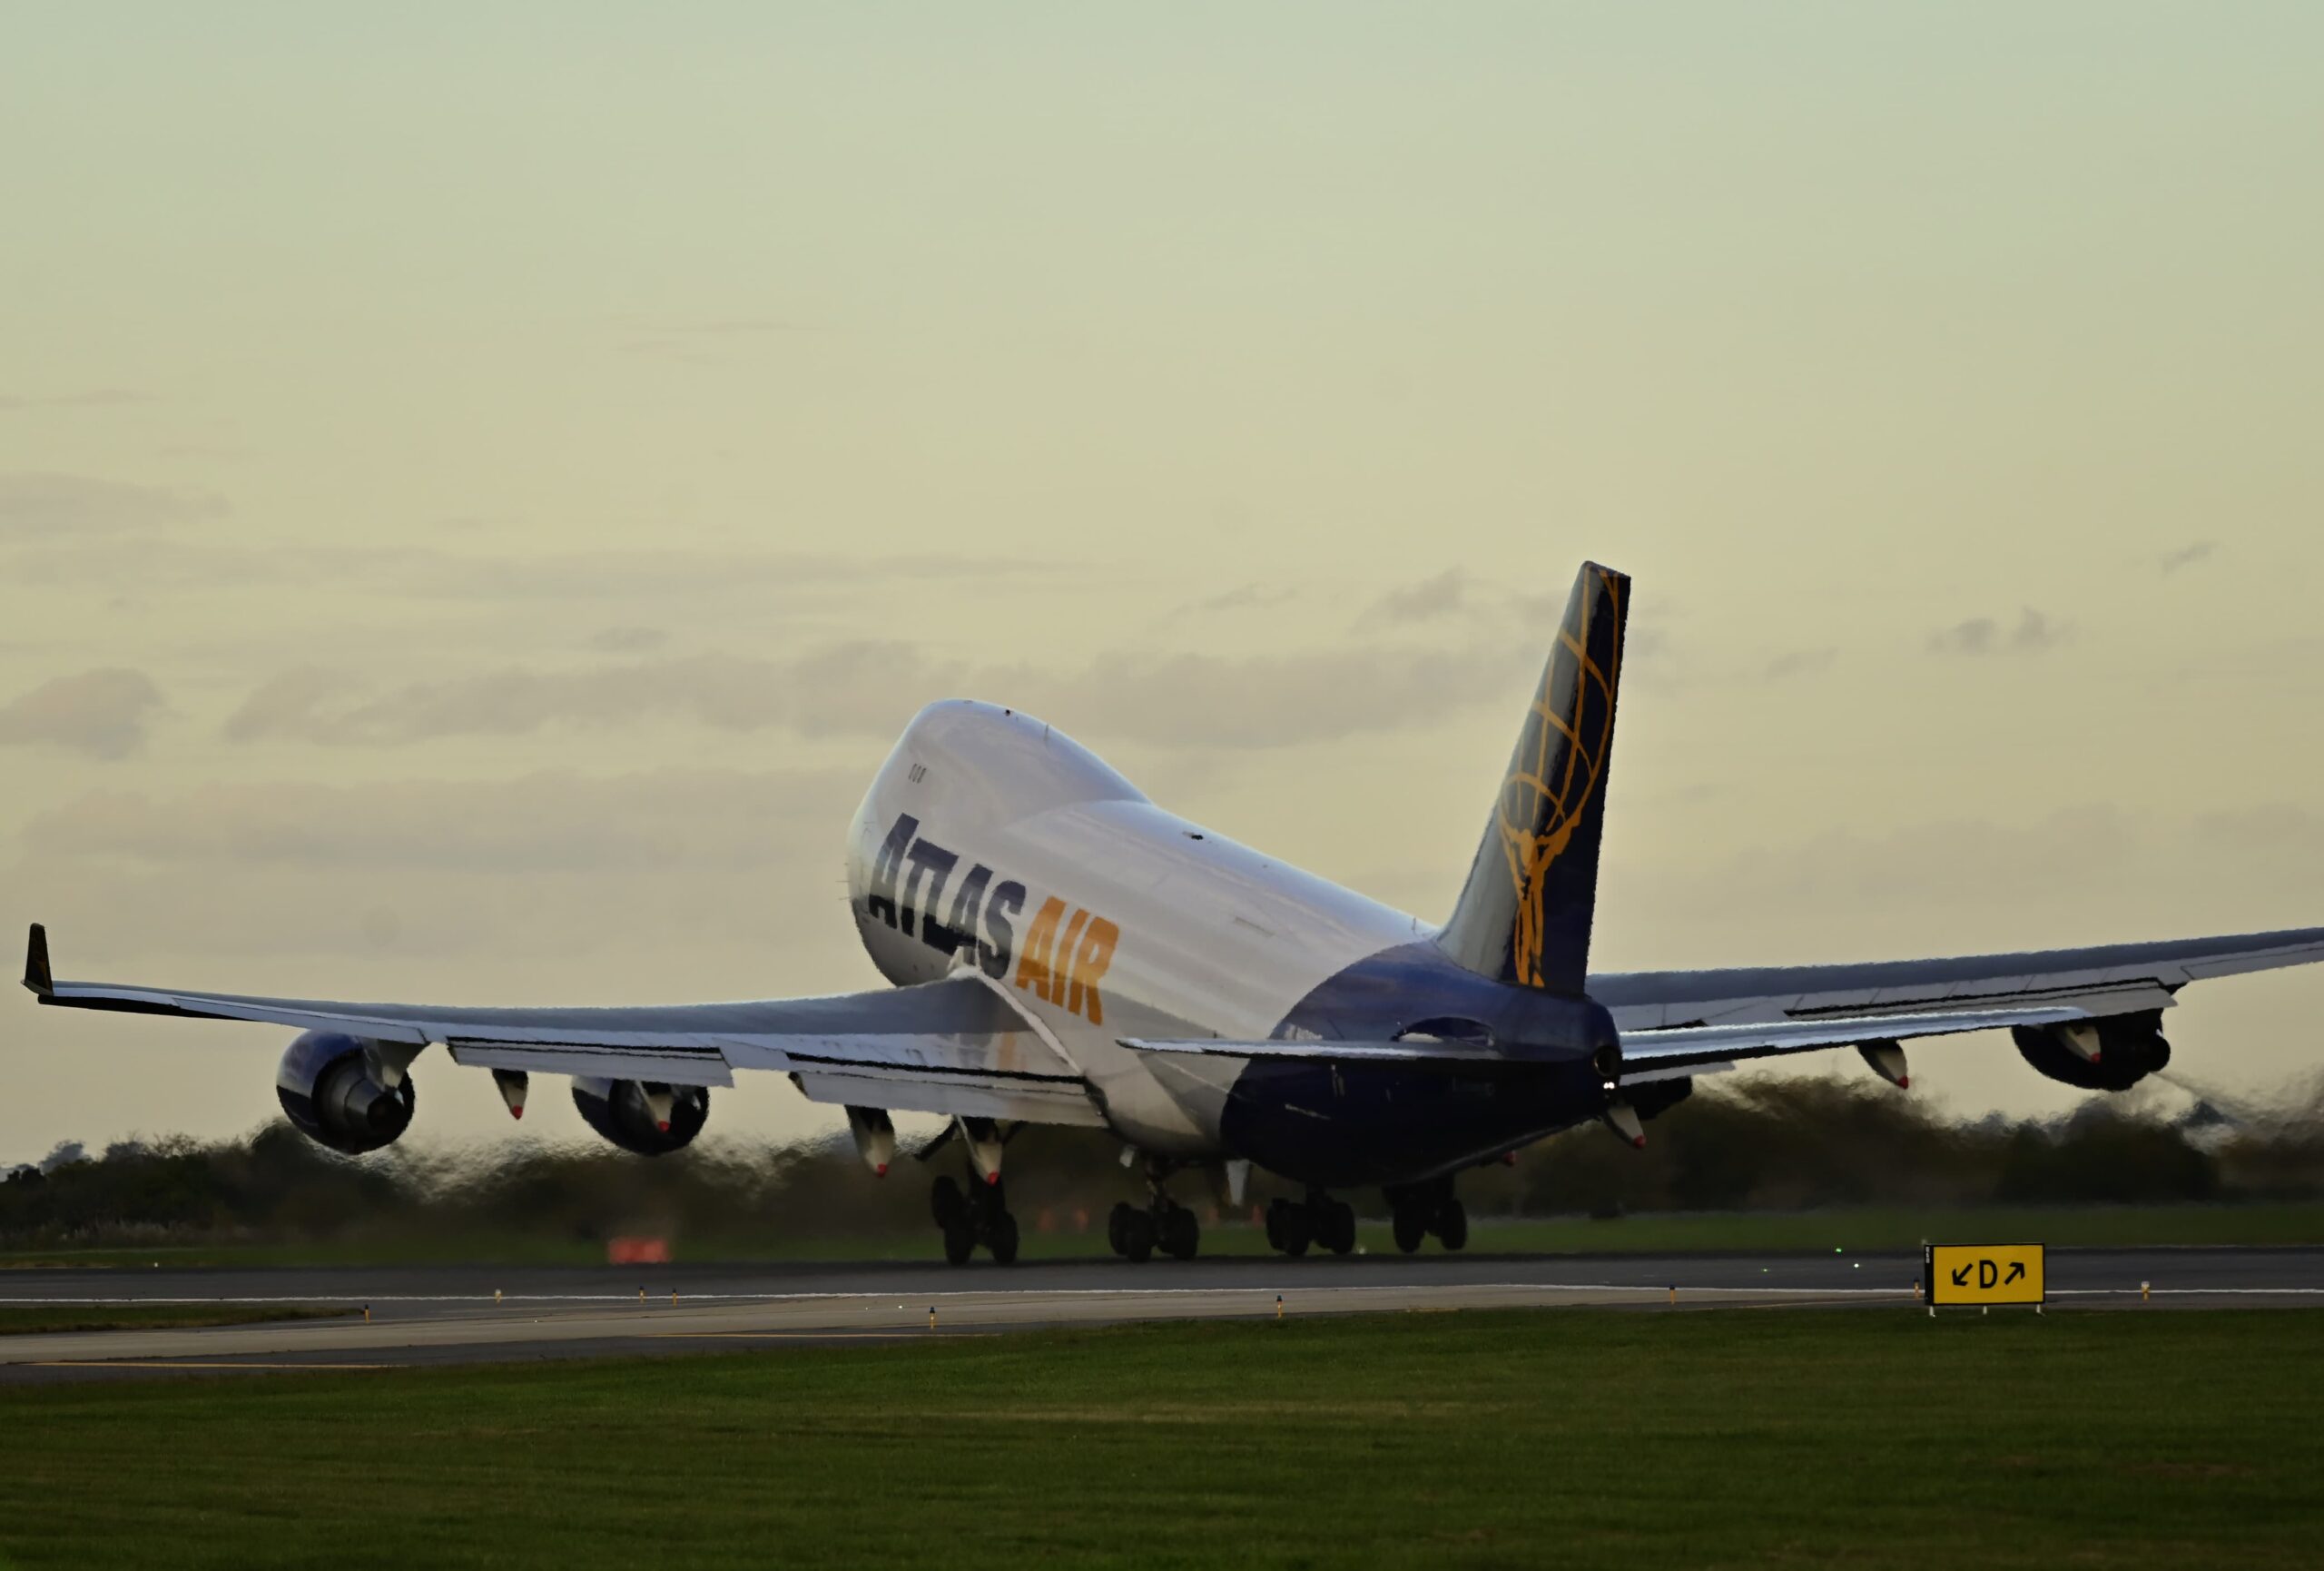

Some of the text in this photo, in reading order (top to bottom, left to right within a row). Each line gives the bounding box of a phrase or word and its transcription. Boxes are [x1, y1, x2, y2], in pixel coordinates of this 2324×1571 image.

[869, 813, 1119, 1026] ATLAS AIR
[1979, 1260, 1997, 1289] D
